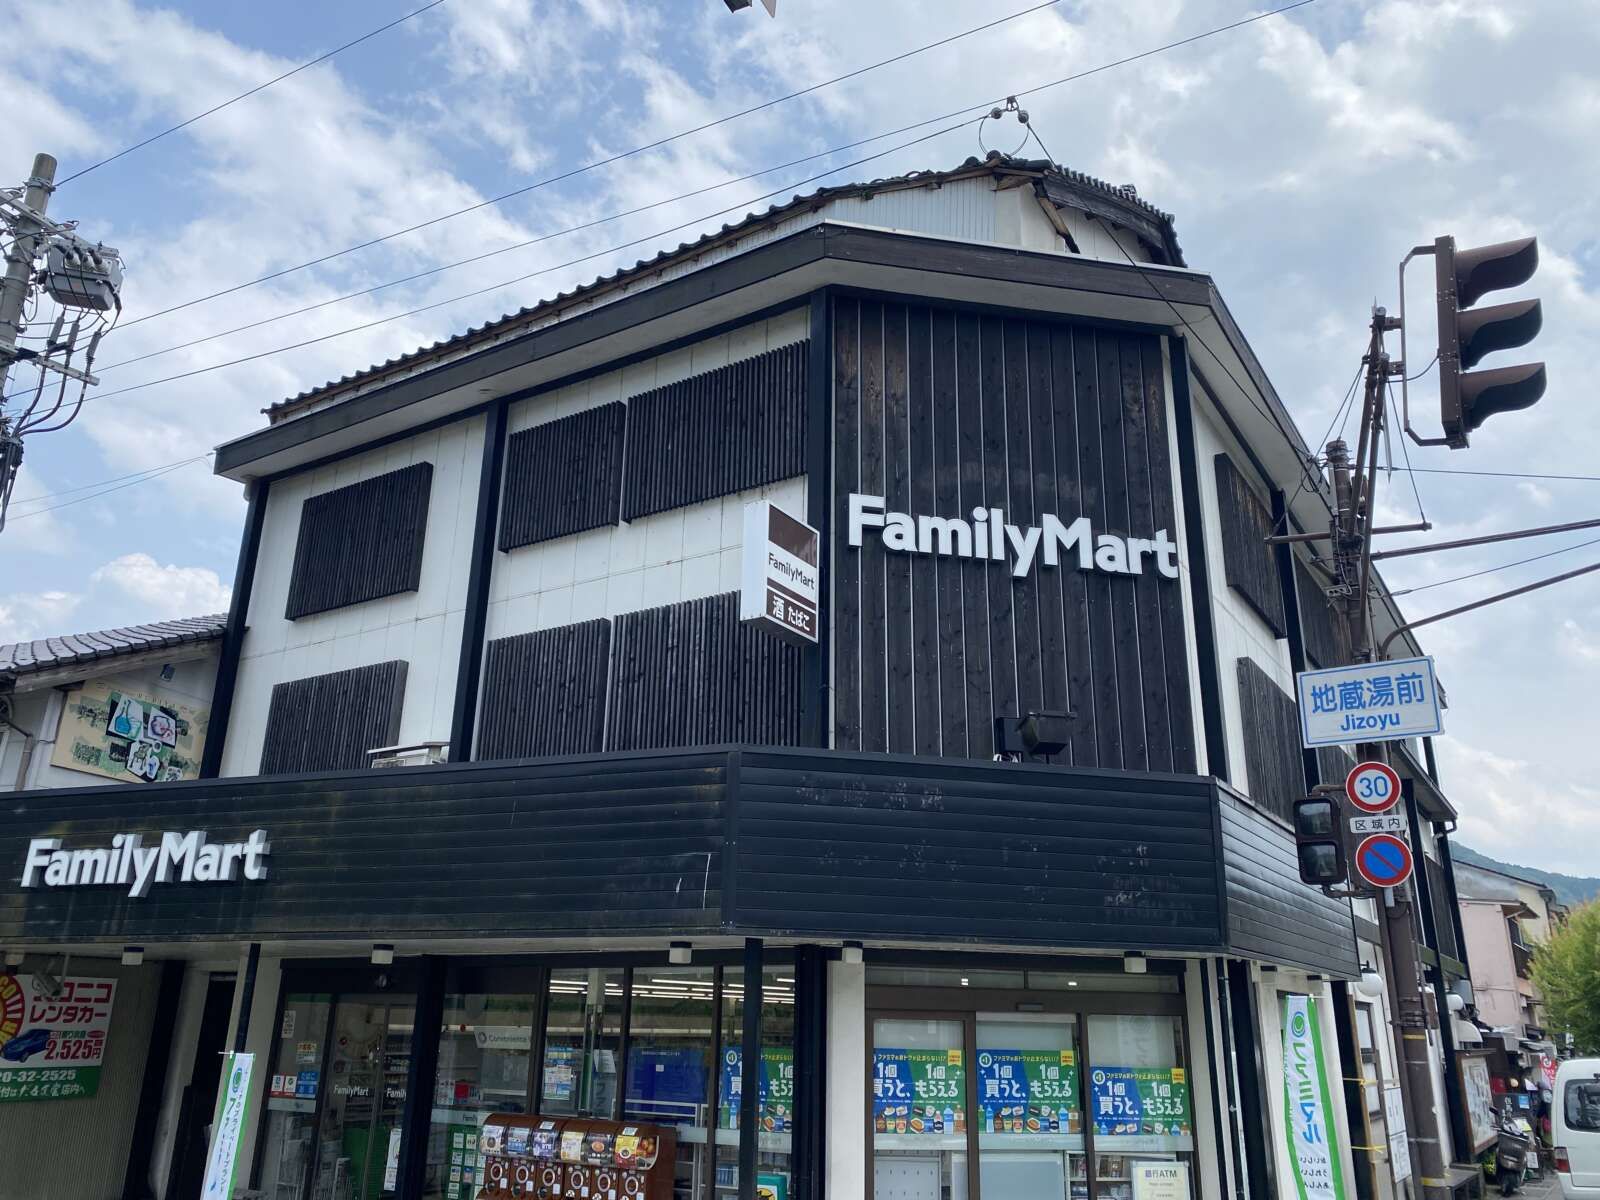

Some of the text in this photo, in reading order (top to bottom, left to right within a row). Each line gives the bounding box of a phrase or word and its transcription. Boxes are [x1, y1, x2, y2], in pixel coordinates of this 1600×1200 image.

[848, 493, 1178, 579] FamilyMart
[768, 552, 815, 590] FamilyMart
[772, 595, 811, 631] 酒 たばこ
[1310, 671, 1425, 714] 地蔵湯前
[1340, 711, 1401, 732] Jizoyu
[1359, 775, 1389, 798] 30
[1354, 817, 1401, 830] 区域内
[21, 829, 270, 898] FamilyMart
[29, 1004, 107, 1024] レンタカー
[0, 1069, 77, 1083] 0-32-2525
[877, 1063, 897, 1078] 1個
[925, 1064, 946, 1079] 1個
[993, 1063, 1013, 1078] 1個
[1039, 1064, 1059, 1079] 1個
[333, 1083, 369, 1097] FamilyMart
[915, 1080, 959, 1098] もらえる
[1030, 1080, 1072, 1098] もらえる
[1106, 1080, 1125, 1096] 1個
[1151, 1081, 1171, 1097] 1個
[1143, 1097, 1184, 1115] もらえる
